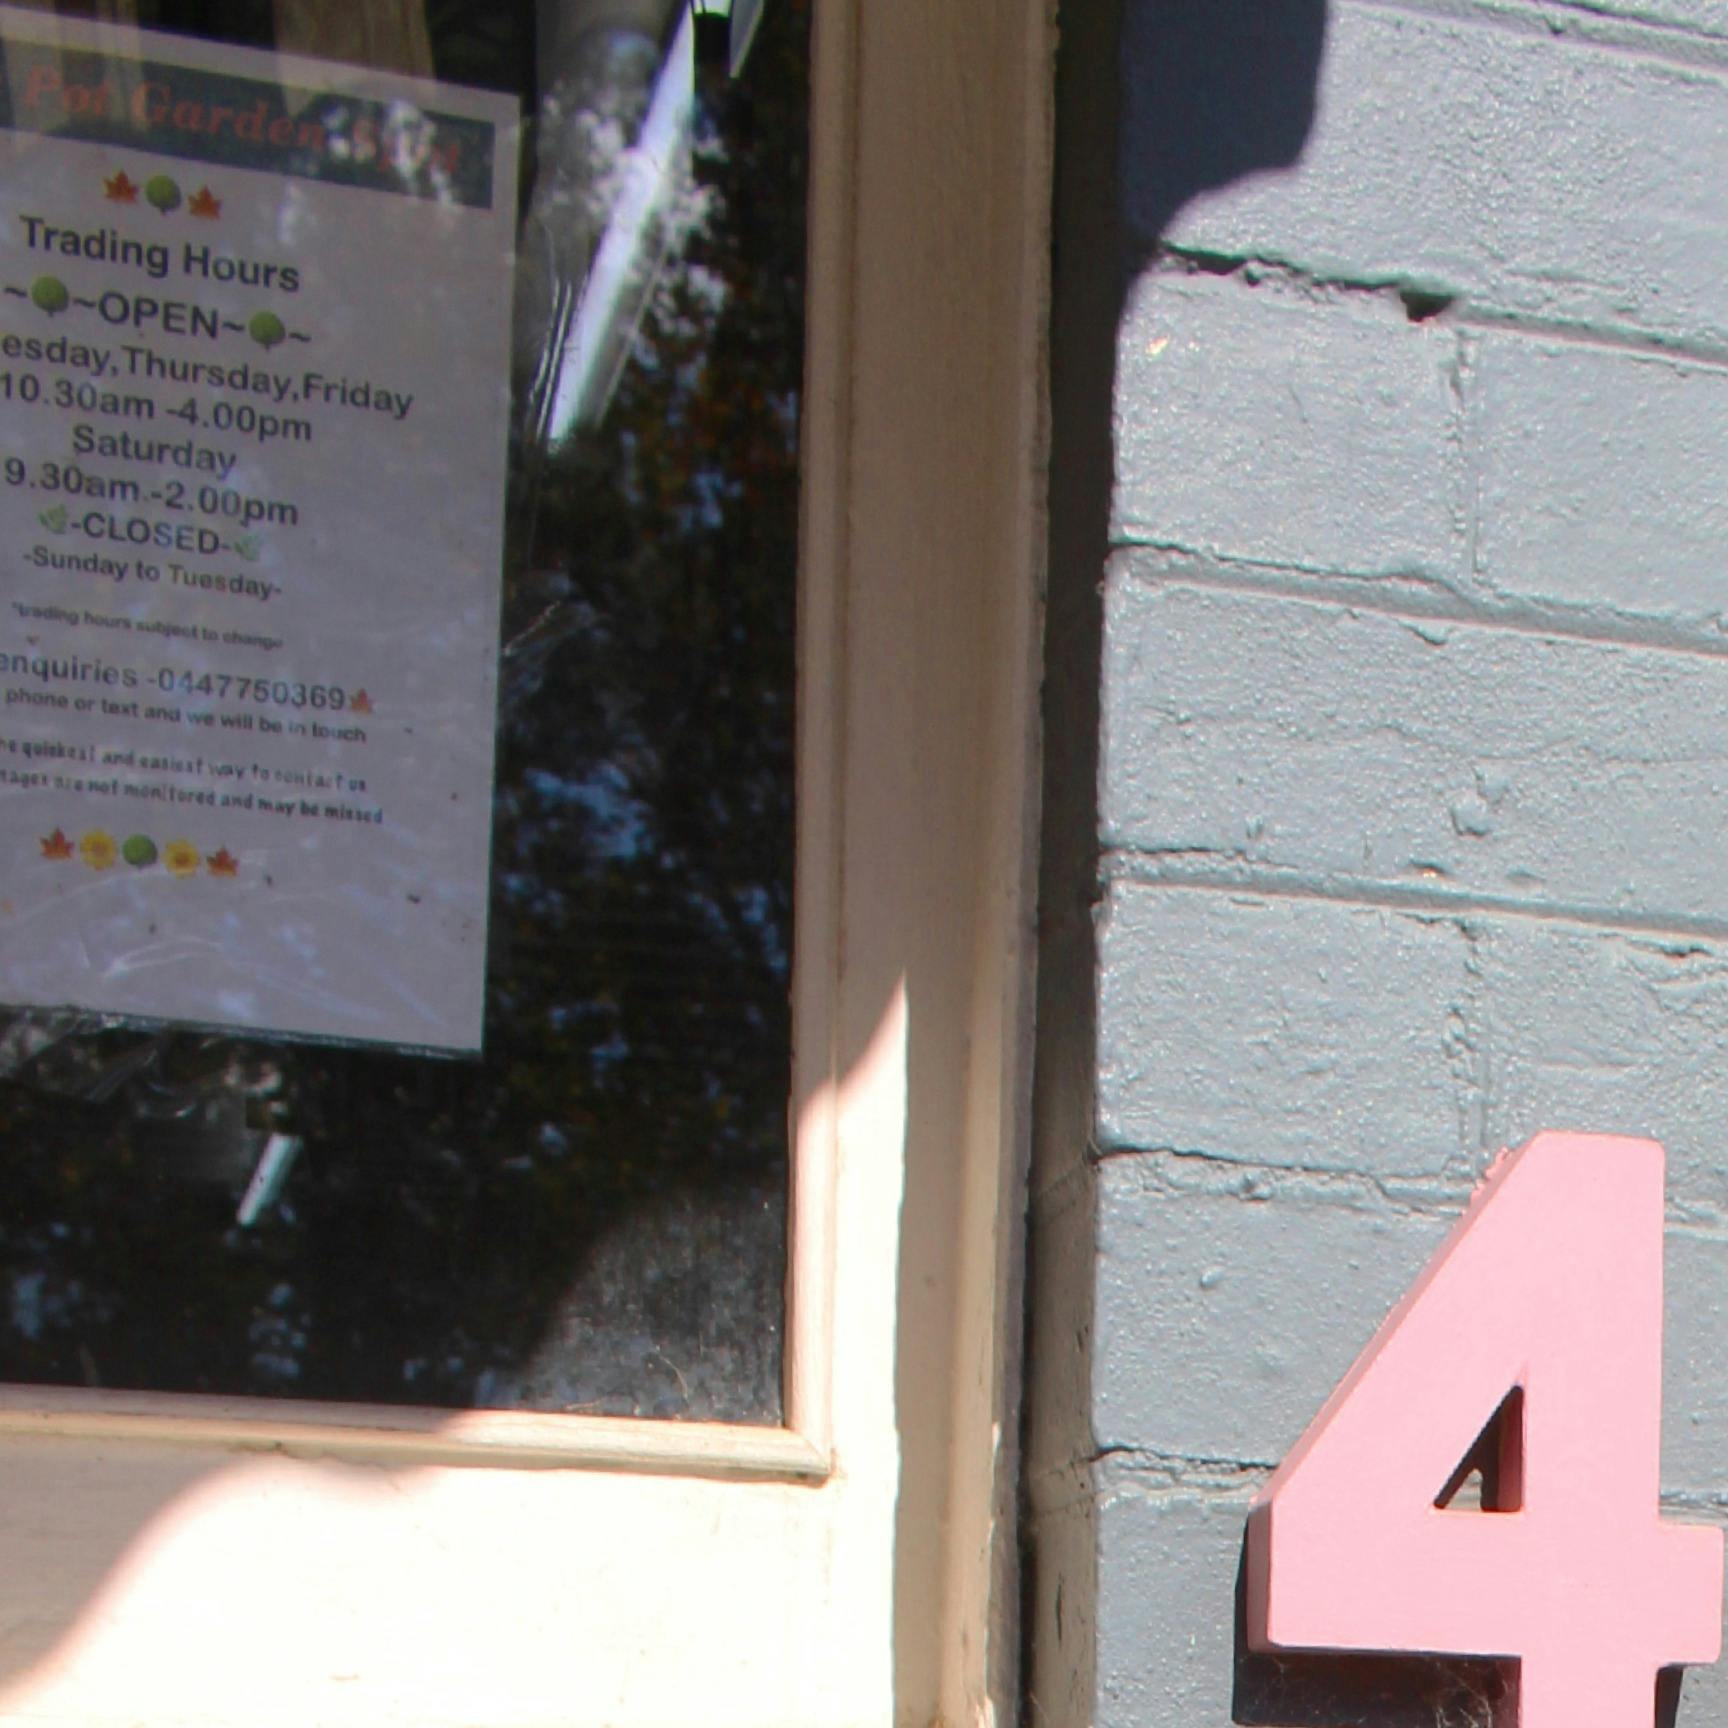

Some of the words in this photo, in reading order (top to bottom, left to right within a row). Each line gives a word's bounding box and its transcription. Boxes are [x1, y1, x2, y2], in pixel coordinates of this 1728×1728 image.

[131, 80, 326, 149] Garden
[19, 214, 169, 279] Trading
[183, 242, 299, 293] Hours
[0, 371, 155, 419] 10.30am
[72, 422, 237, 480] Saturday
[136, 560, 160, 581] to
[84, 610, 131, 630] hours
[136, 621, 198, 640] subject
[202, 626, 218, 641] to
[222, 629, 284, 651] change
[5, 686, 70, 709] phone
[74, 697, 95, 712] or
[101, 697, 139, 719] text
[144, 704, 181, 723] and
[187, 711, 215, 727] we
[220, 713, 254, 731] will
[259, 716, 283, 734] be
[312, 721, 367, 743] touch
[102, 750, 135, 766] and
[252, 763, 270, 782] to
[349, 777, 367, 792] us
[88, 778, 118, 796] not
[220, 793, 253, 810] and
[258, 798, 295, 818] may
[300, 799, 319, 816] be
[325, 803, 384, 824] missed
